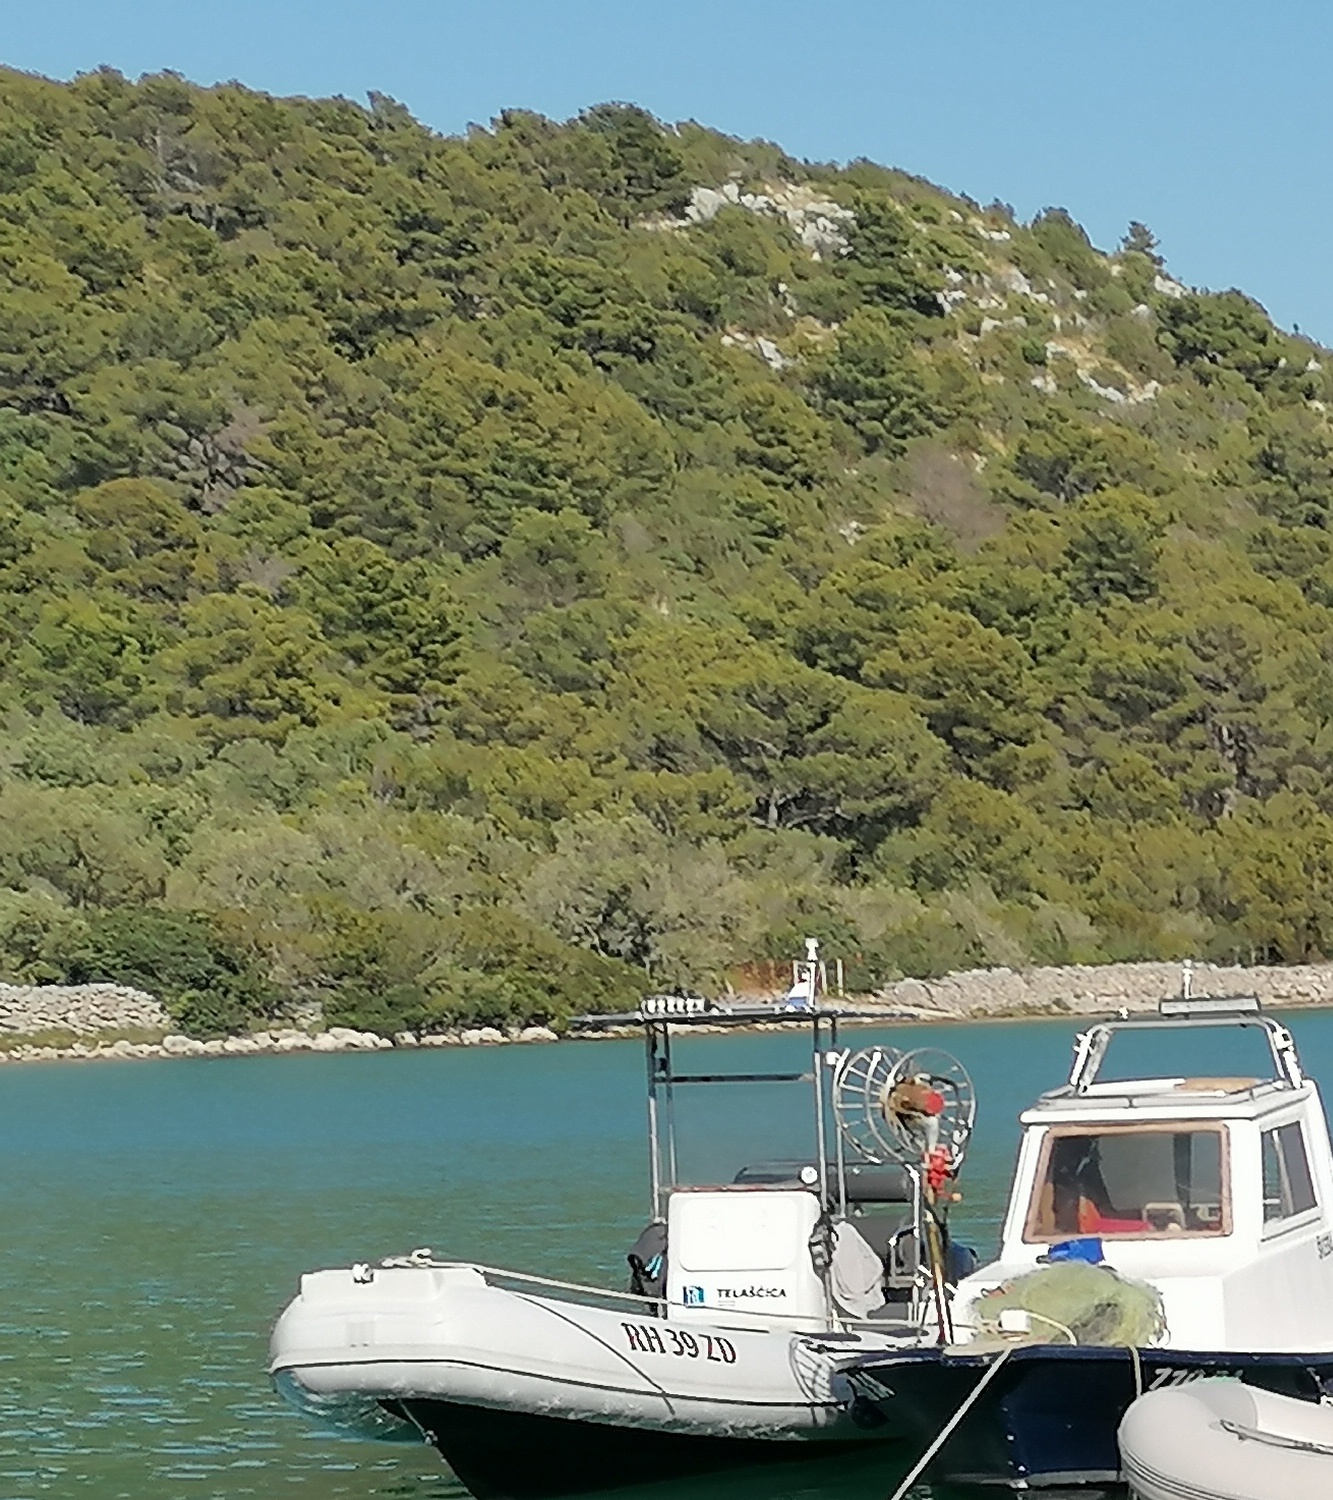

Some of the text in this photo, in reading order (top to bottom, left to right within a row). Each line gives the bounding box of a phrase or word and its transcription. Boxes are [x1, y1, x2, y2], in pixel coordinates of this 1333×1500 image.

[621, 1322, 737, 1364] RH 39 ZD
